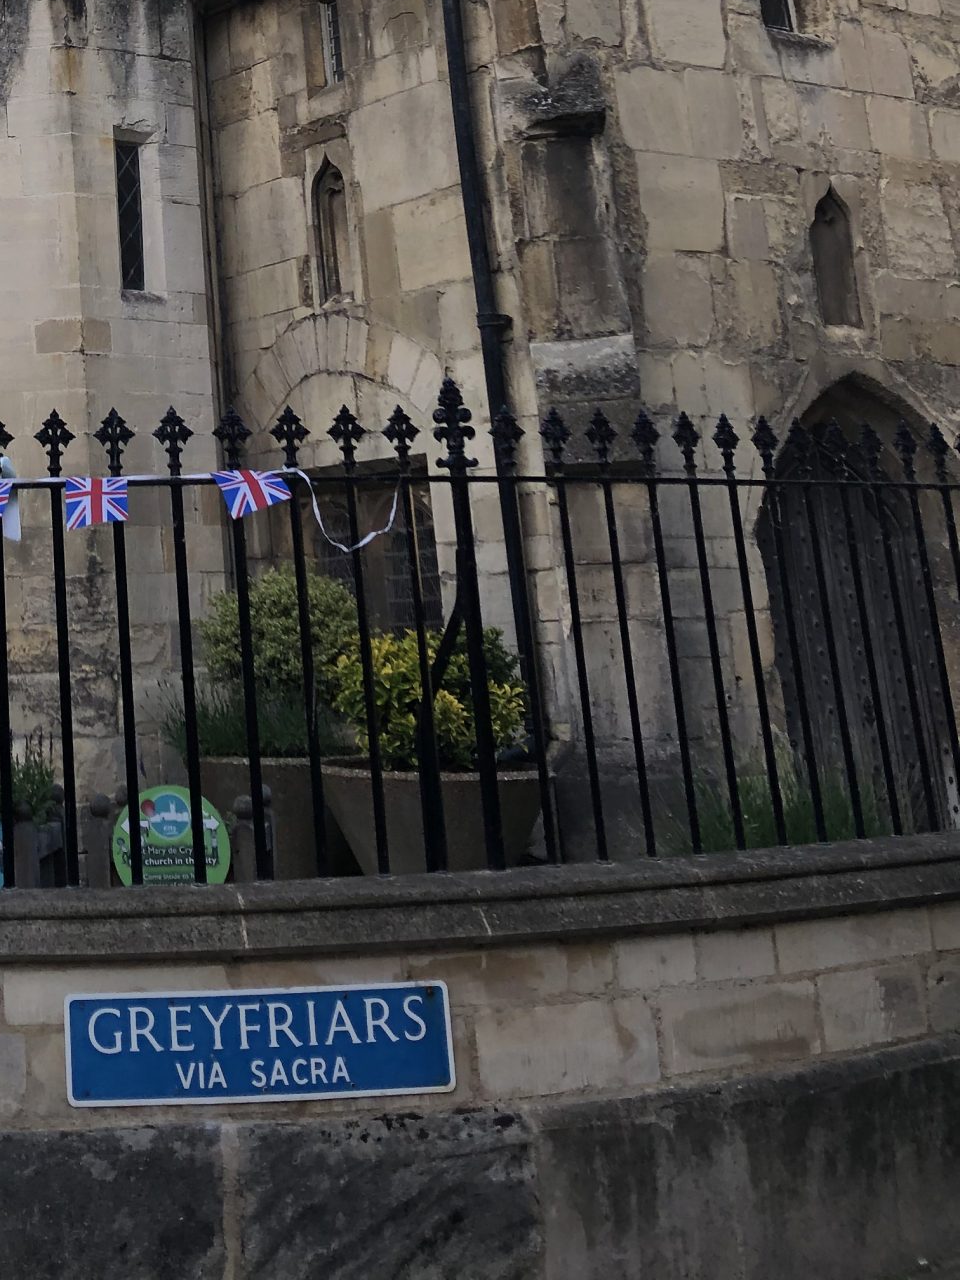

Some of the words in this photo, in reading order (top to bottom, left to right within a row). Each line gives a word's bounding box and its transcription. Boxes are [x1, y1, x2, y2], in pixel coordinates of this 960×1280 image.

[148, 847, 165, 855] Mary
[179, 847, 192, 855] Cry
[88, 995, 428, 1055] GREYFRIARS
[176, 1062, 228, 1090] VIA
[250, 1056, 351, 1088] SACRA
